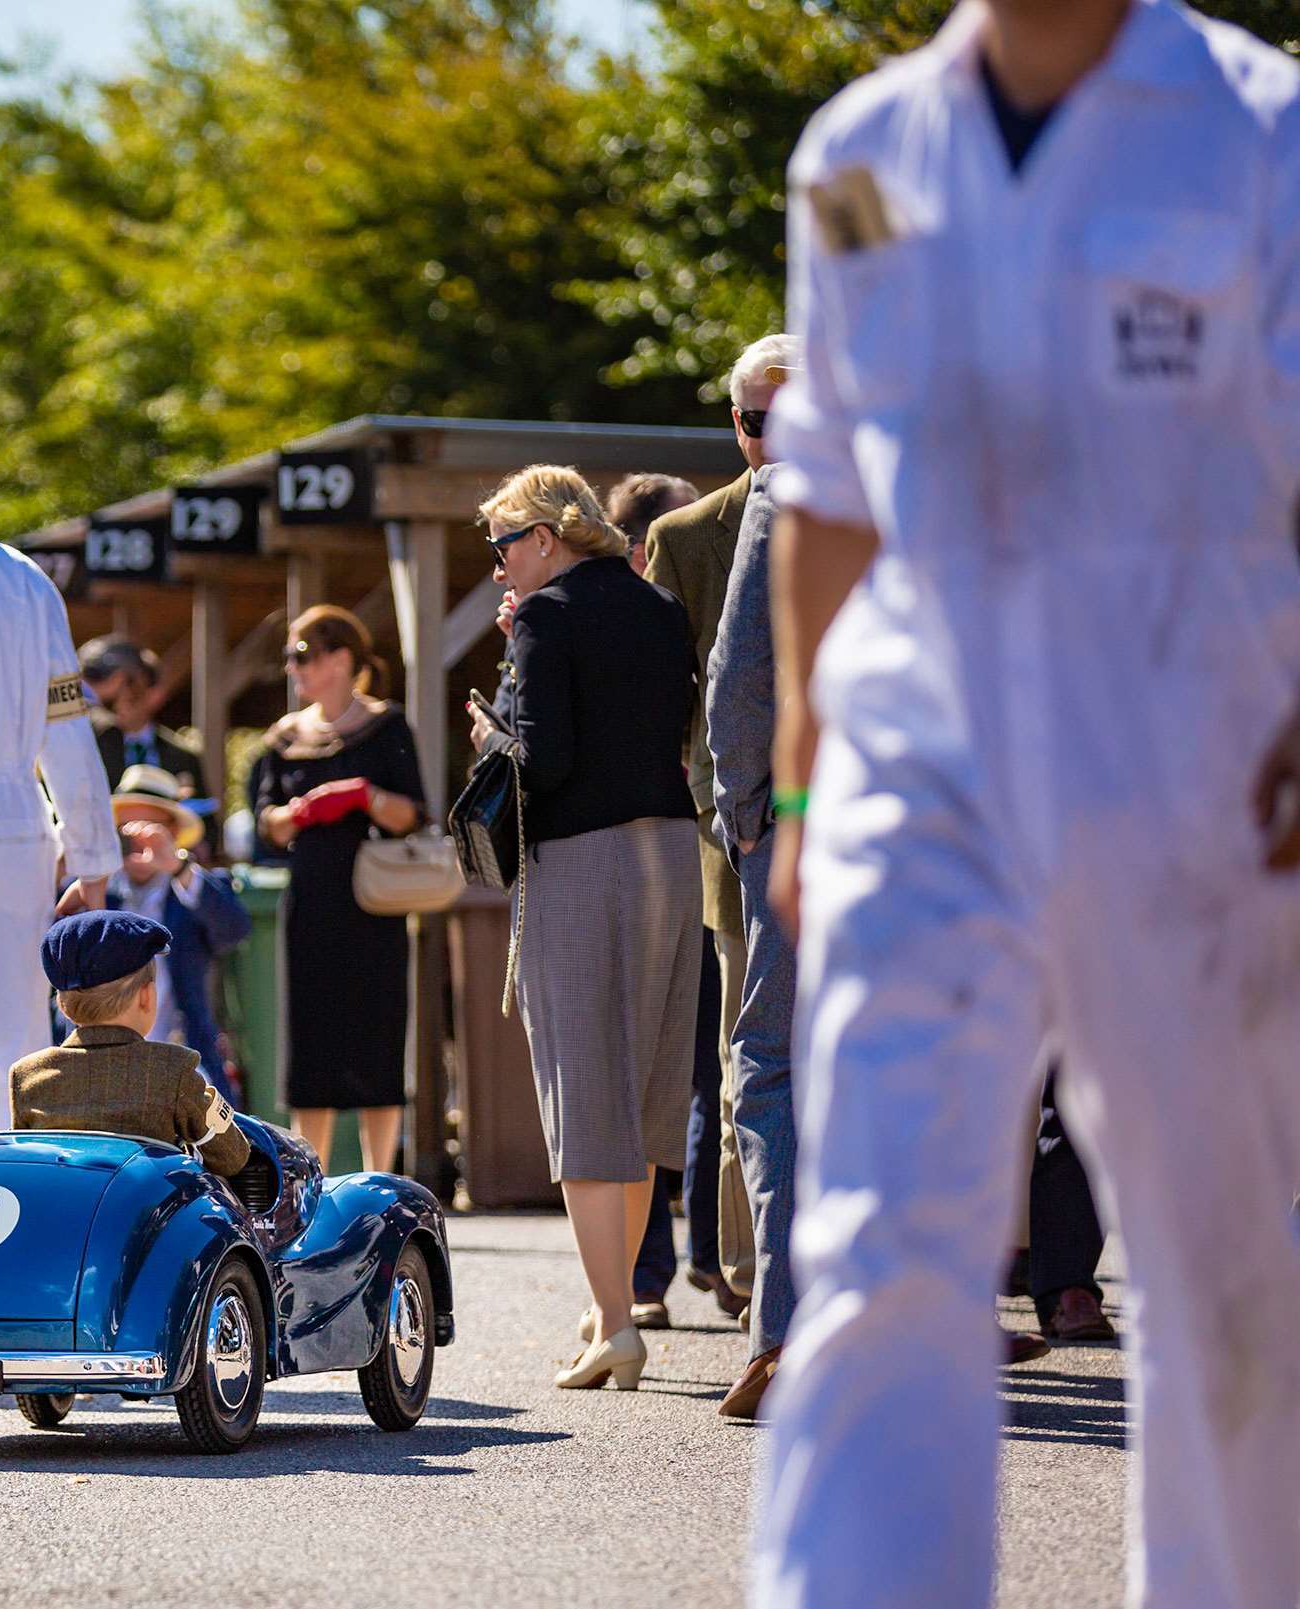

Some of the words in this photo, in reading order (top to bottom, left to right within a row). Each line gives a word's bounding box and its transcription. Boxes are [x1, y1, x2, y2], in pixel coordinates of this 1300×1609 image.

[278, 464, 354, 511] 129
[171, 496, 242, 542] 129
[85, 527, 154, 571] 128
